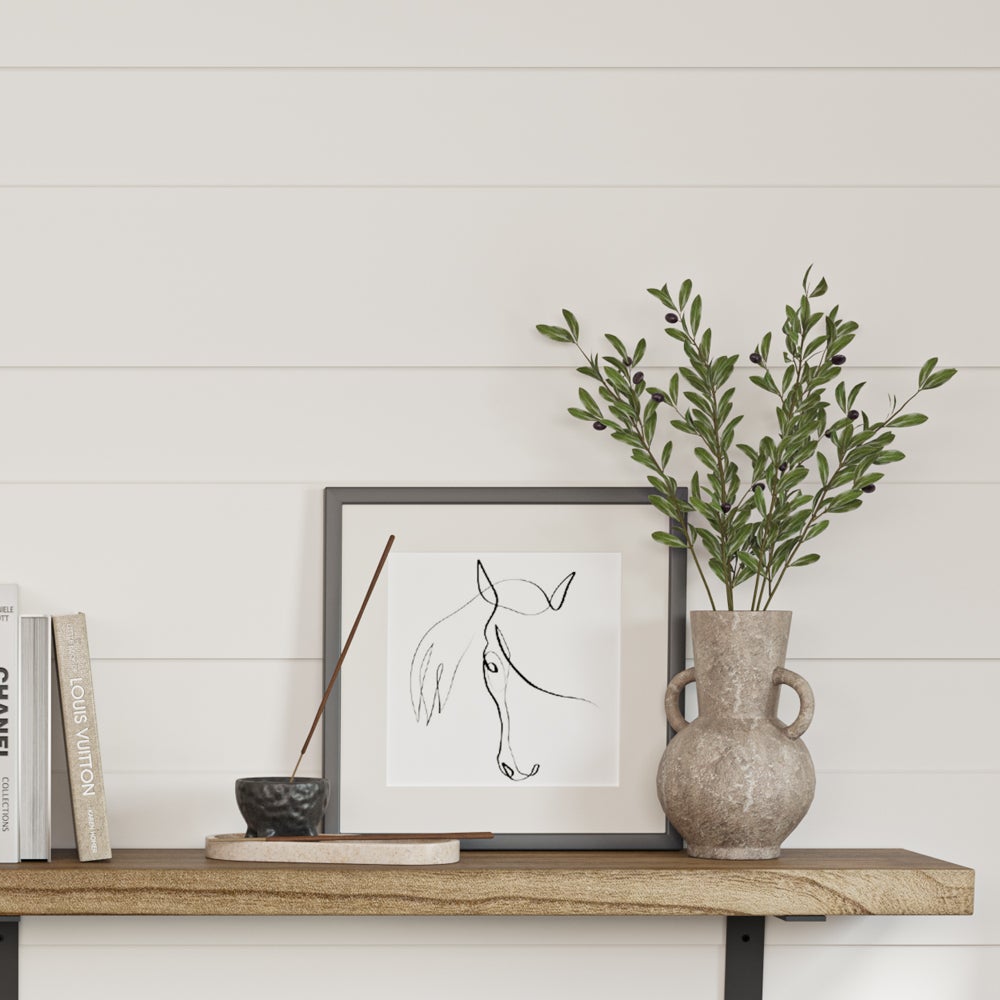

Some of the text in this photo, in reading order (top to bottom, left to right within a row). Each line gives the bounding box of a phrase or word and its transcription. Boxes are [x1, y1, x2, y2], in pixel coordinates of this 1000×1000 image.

[69, 677, 88, 724] LOUIS
[75, 727, 96, 796] VUITTON
[1, 776, 10, 832] COLLECTIONS
